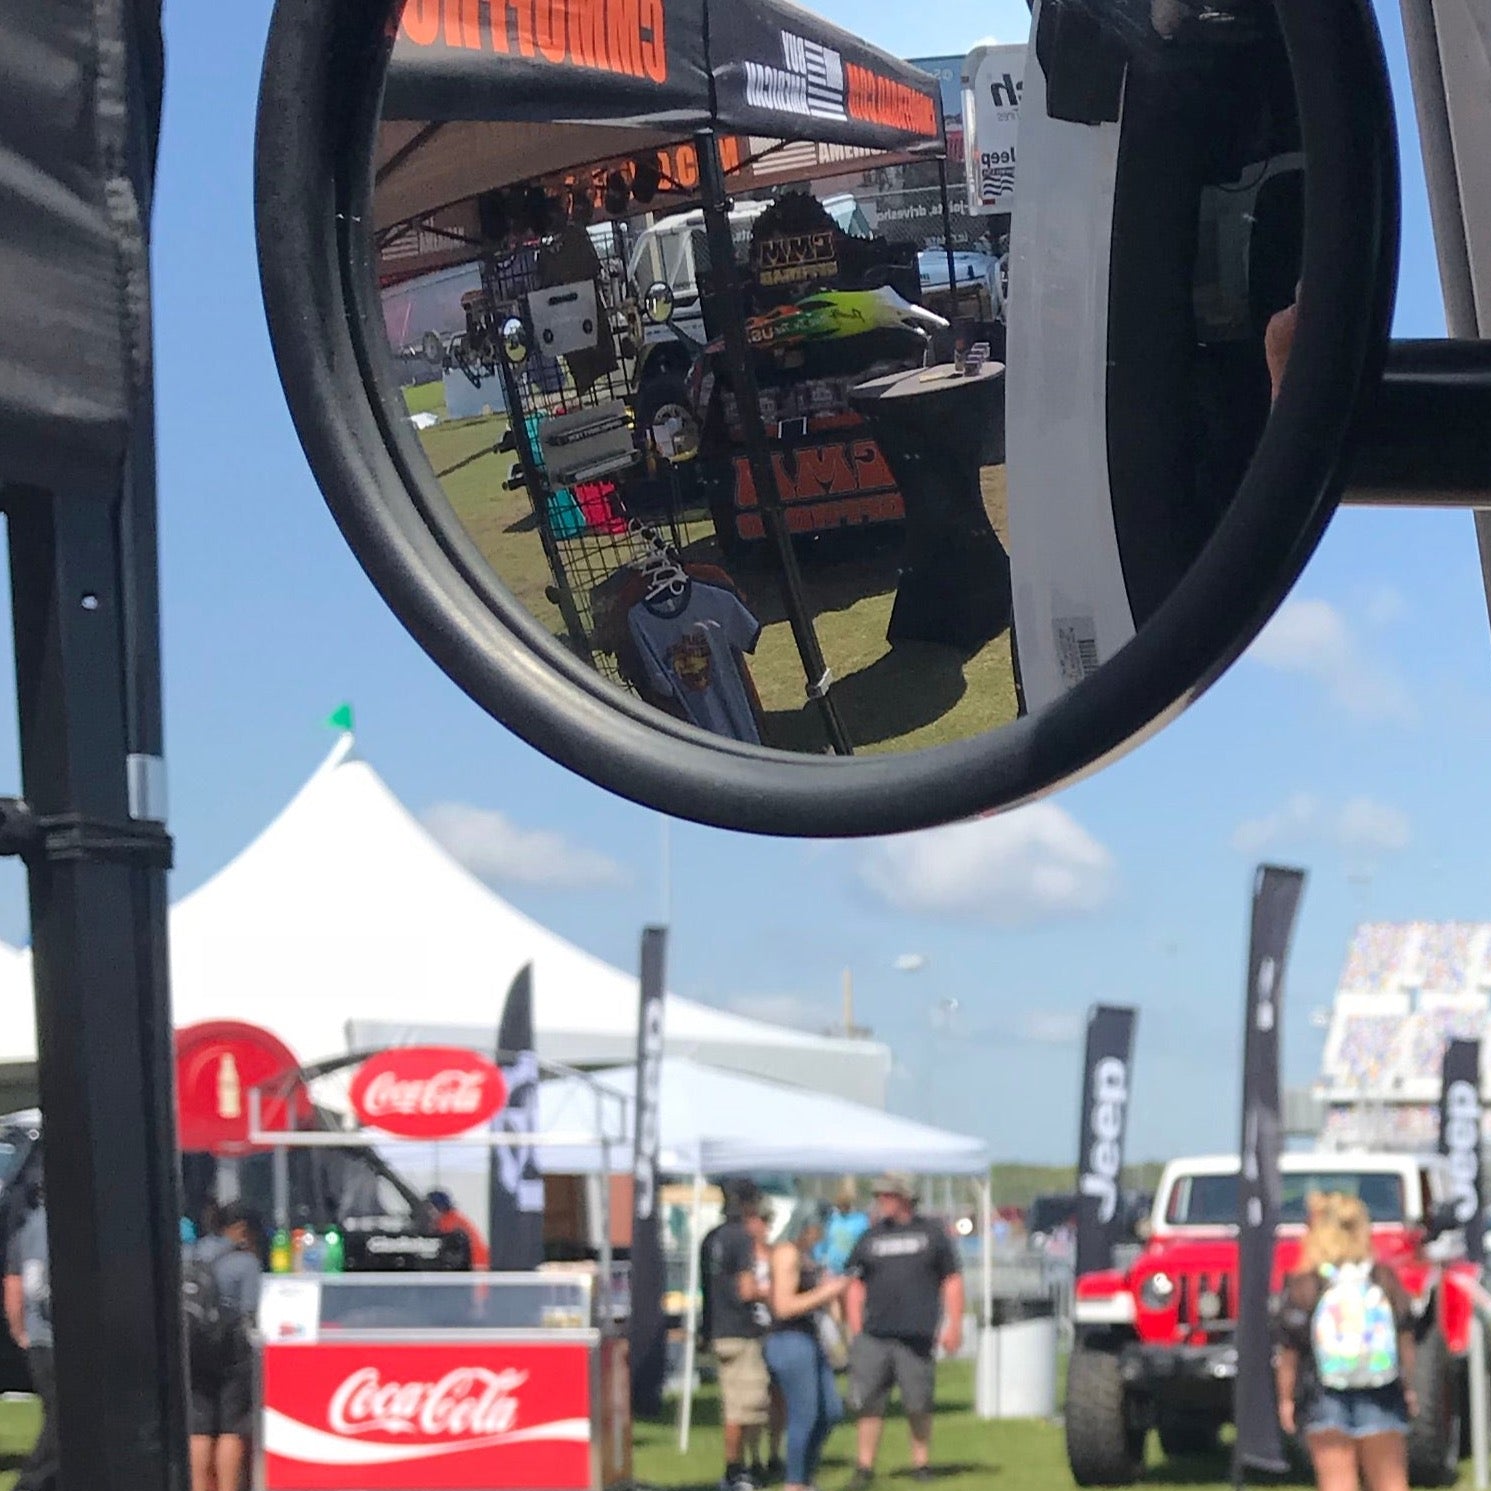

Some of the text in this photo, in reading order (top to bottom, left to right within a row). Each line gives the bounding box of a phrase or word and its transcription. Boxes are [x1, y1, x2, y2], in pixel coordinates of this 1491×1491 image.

[1079, 1056, 1128, 1223] Jeep
[1451, 1079, 1482, 1223] Jeep
[328, 1365, 530, 1436] Coca-Cola
